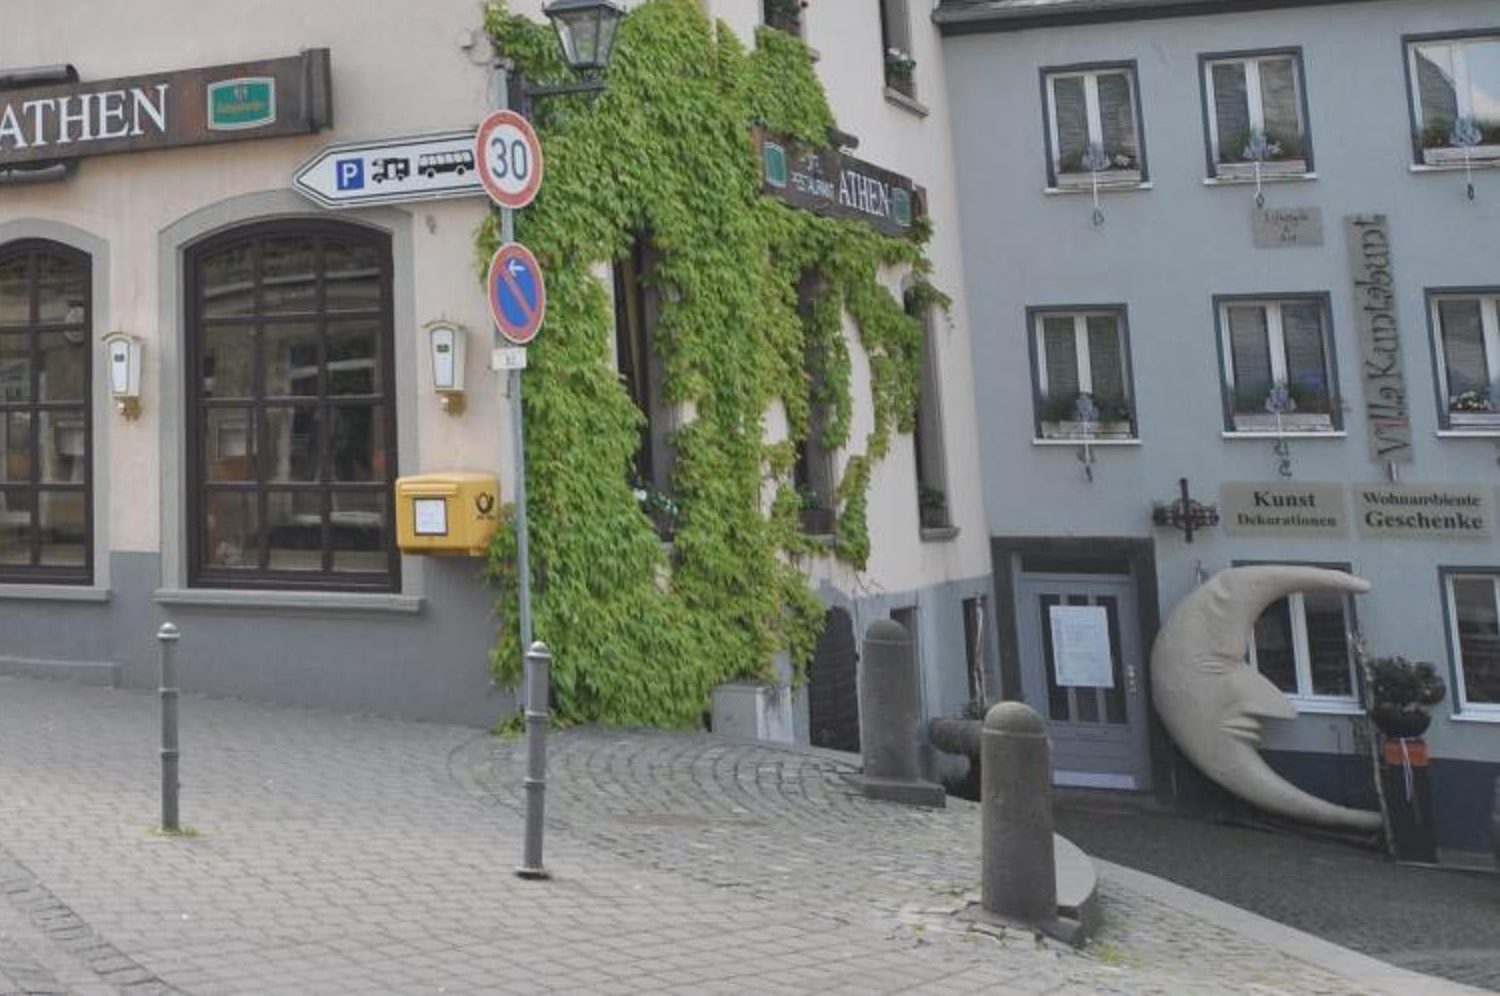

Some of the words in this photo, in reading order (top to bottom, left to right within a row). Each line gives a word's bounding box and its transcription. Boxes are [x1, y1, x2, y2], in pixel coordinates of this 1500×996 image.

[492, 138, 528, 180] 30
[342, 163, 358, 187] P
[839, 171, 891, 221] ATHEN
[1253, 490, 1316, 508] Kunst
[1363, 490, 1481, 507] Wohnambiente
[1236, 512, 1338, 527] Dekorationen
[1364, 509, 1484, 530] Geschenke
